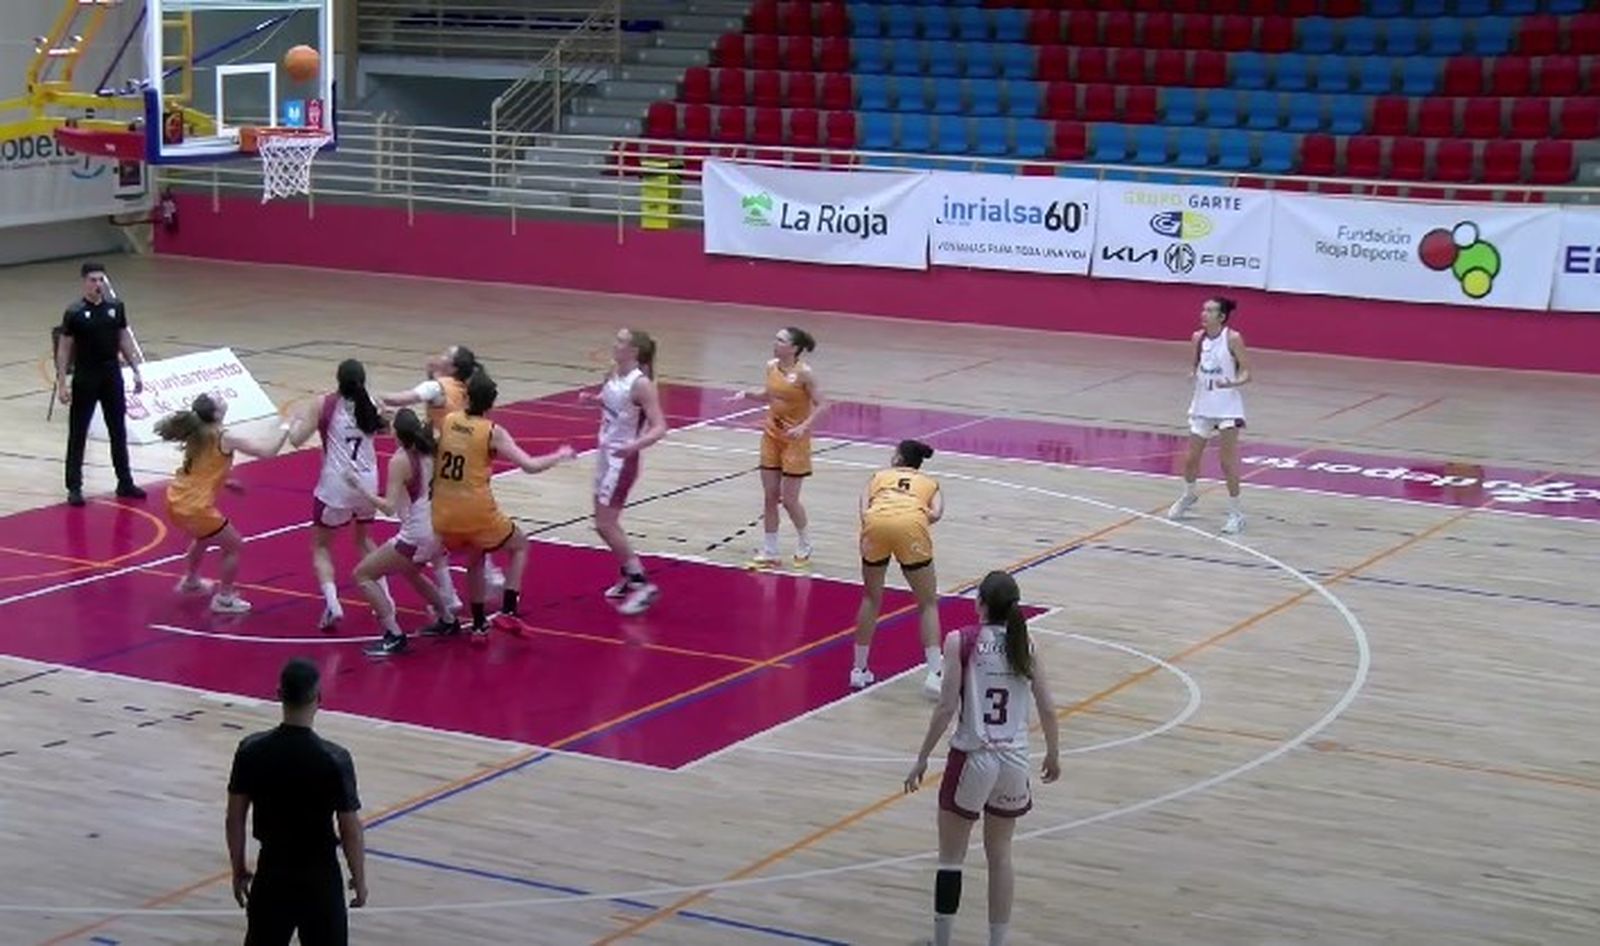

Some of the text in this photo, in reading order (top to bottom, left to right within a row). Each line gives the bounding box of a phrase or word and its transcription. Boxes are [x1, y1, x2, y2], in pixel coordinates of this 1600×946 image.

[943, 194, 1043, 225] inrialsa
[1188, 194, 1242, 211] GARTE
[781, 202, 888, 239] La Rioja
[1351, 243, 1408, 262] Deporte
[345, 436, 363, 461] 7
[440, 450, 466, 482] 28
[983, 687, 1010, 726] 3
